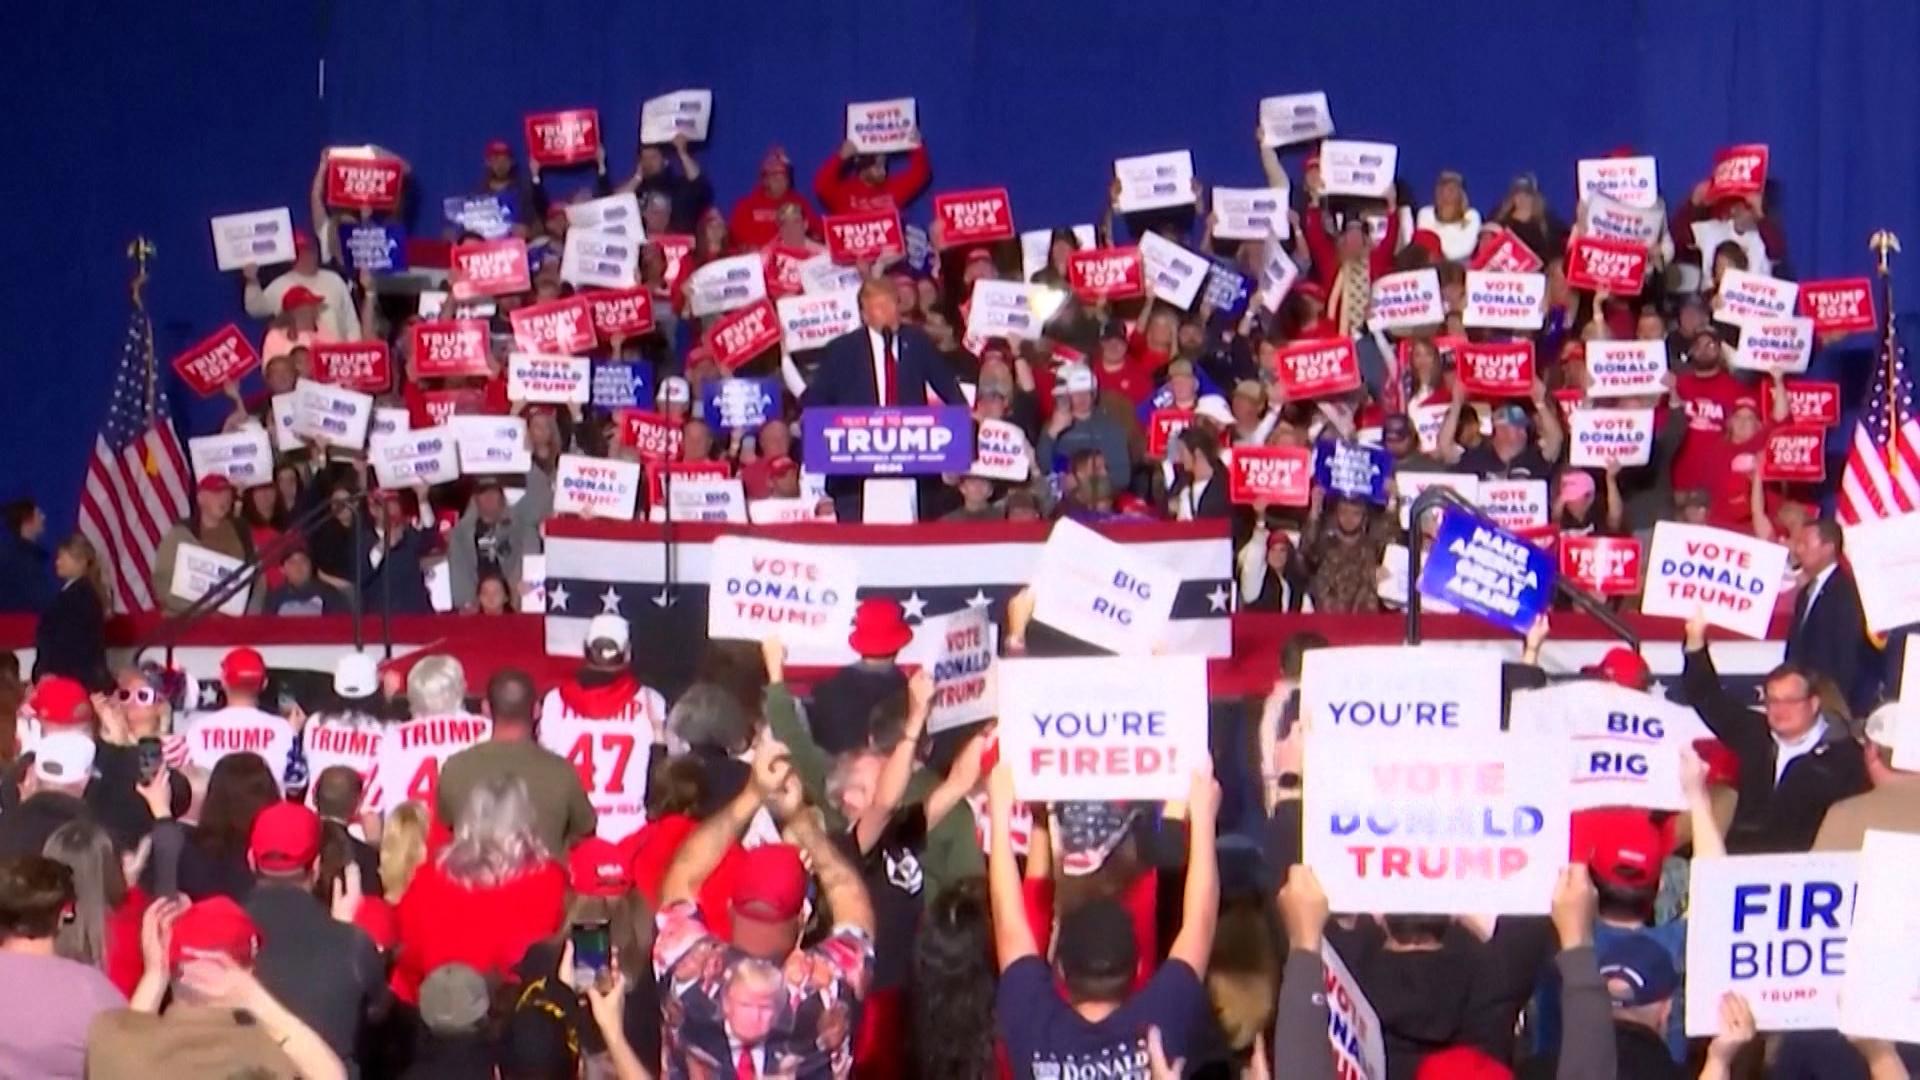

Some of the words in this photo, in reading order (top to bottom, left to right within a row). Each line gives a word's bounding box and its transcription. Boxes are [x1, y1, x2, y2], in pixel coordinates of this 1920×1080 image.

[866, 108, 901, 121] VOTE
[534, 118, 594, 138] TRUMP
[855, 118, 911, 133] DONALD
[860, 131, 909, 144] TRUMP
[337, 166, 397, 182] TRUMP
[1597, 167, 1636, 178] VOTE
[344, 180, 387, 194] 2024
[1587, 177, 1649, 191] DONALD
[944, 200, 1003, 218] TRUMP
[954, 213, 998, 230] 2024
[1592, 216, 1652, 235] DONALD
[1606, 210, 1643, 225] VOTE
[832, 219, 895, 238] TRUMP
[843, 232, 888, 248] 2024
[457, 248, 521, 271] TRUMP
[1580, 246, 1641, 267] TRUMP
[468, 262, 513, 281] 2024
[1074, 256, 1135, 275] TRUMP
[1085, 271, 1127, 287] 2024
[1382, 280, 1420, 294] VOTE
[1485, 281, 1525, 293] VOTE
[1740, 282, 1777, 297] VOTE
[1808, 289, 1866, 305] TRUMP
[595, 296, 646, 316] RUMP
[1472, 292, 1536, 305] DONALD
[1725, 290, 1786, 311] DONALD
[798, 301, 838, 315] VOTE
[1379, 303, 1430, 319] TRUMP
[1478, 306, 1531, 317] TRUMP
[1817, 304, 1859, 319] 2024
[521, 306, 583, 335] TRUMP
[715, 307, 767, 346] TRUMP
[789, 310, 852, 331] DONALD
[1762, 326, 1797, 338] VOTE
[421, 331, 482, 350] TRUMP
[1747, 337, 1805, 350] DONALD
[185, 337, 238, 374] TRUMP
[320, 351, 382, 365] TRUMP
[1284, 347, 1350, 370] TRUMP
[1465, 352, 1529, 367] TRUMP
[1605, 350, 1645, 361] VOTE
[1752, 349, 1800, 361] TRUMP
[328, 363, 376, 378] 2024
[530, 359, 570, 370] VOTE
[1294, 363, 1341, 381] 2024
[1473, 365, 1519, 379] 2024
[1593, 360, 1659, 375] DONALD
[517, 369, 582, 381] DONALD
[1602, 374, 1654, 387] TRUMP
[524, 381, 577, 392] TRUMP
[1593, 419, 1634, 431] VOTE
[823, 427, 953, 453] TRUMP
[981, 429, 1010, 440] OTE
[1579, 430, 1645, 444] DONALD
[980, 441, 1021, 456] NALD
[1586, 444, 1639, 456] TRUMP
[1769, 435, 1819, 451] TRUMP
[981, 455, 1014, 467] UMP
[1241, 457, 1299, 472] TRUMP
[1775, 448, 1811, 465] 2024
[579, 466, 617, 480] VOTE
[1245, 469, 1294, 487] 2024
[563, 477, 627, 494] DONALD
[568, 491, 620, 505] TRUMP
[1490, 490, 1527, 501] VOTE
[1480, 502, 1539, 514] ONALD
[1502, 516, 1535, 528] UMP
[1569, 549, 1636, 562] TRUMP
[1687, 541, 1751, 570] VOTE
[752, 556, 817, 581] VOTE
[1661, 559, 1764, 594] DONALD
[726, 578, 839, 606] DONALD
[1112, 570, 1152, 600] BIG
[1667, 582, 1752, 612] TRUMP
[735, 601, 828, 627] TRUMP
[1092, 597, 1132, 626] RIG
[945, 626, 980, 652] VOTE
[934, 651, 991, 682] DONALD
[937, 677, 986, 708] TRUMP
[1328, 700, 1460, 728] YOU'RE
[1033, 712, 1167, 738] YOU'RE
[1606, 711, 1665, 739] BIG
[202, 728, 275, 751] TRUMP
[400, 719, 487, 749] TRUMP
[567, 733, 635, 794] 47
[1030, 746, 1177, 776] FIRED!
[1590, 751, 1649, 776] RIG
[1374, 762, 1505, 797] VOTE
[1330, 806, 1544, 837] DONALD
[1347, 847, 1529, 879] TRUMP
[1733, 881, 1858, 934] FIR
[1730, 937, 1849, 981] BIDE
[1761, 988, 1818, 1002] TRUMP
[1062, 1050, 1149, 1080] DONALD
